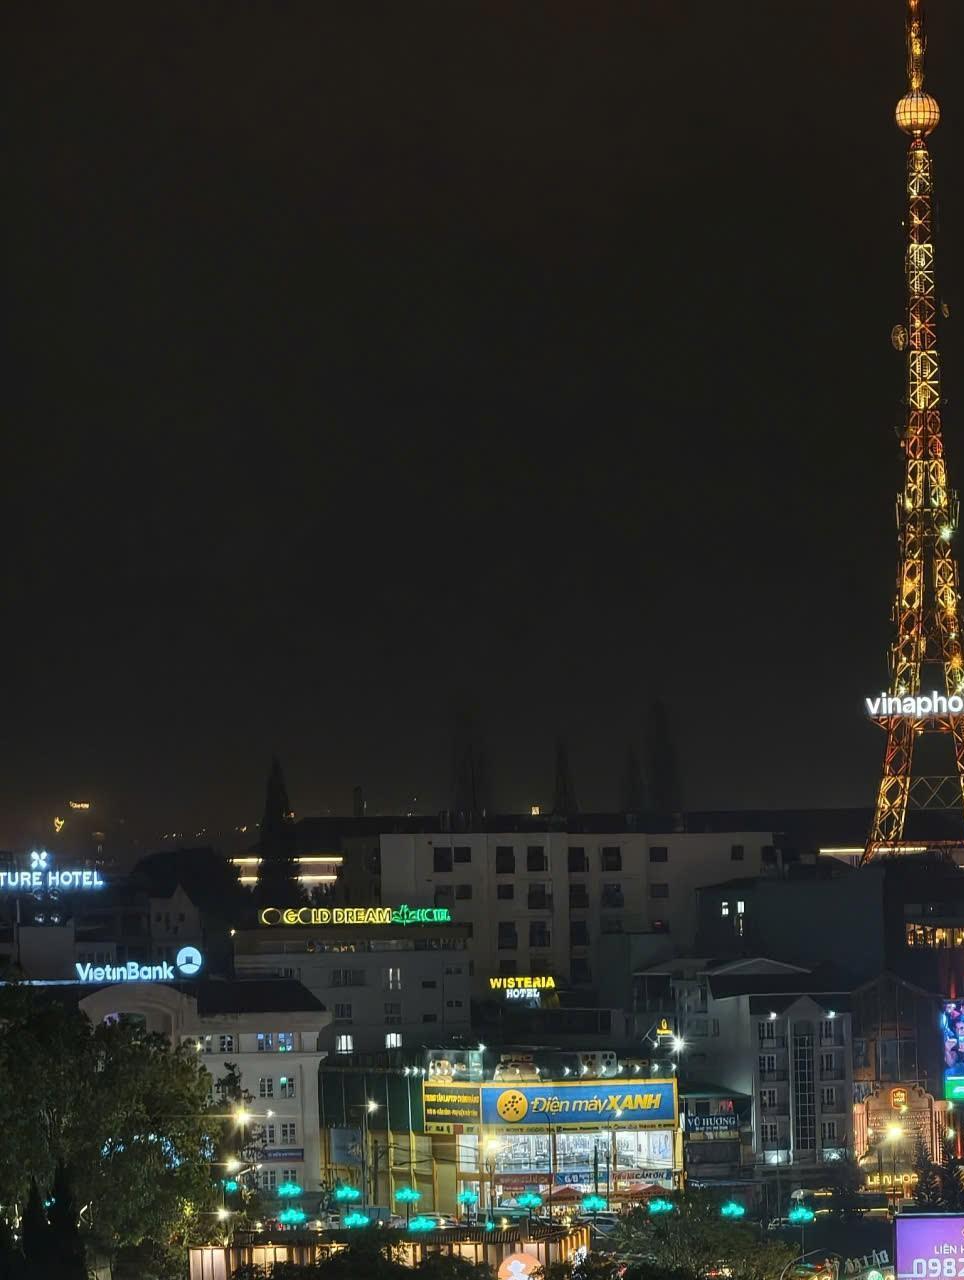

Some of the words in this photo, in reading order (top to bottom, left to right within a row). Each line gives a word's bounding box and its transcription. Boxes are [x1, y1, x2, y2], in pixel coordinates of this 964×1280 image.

[48, 871, 103, 886] HOTEL
[333, 907, 392, 924] DREAM
[75, 961, 175, 981] VietinBank
[489, 976, 556, 989] WISTERIA
[506, 988, 540, 999] HOTEL
[531, 1096, 570, 1115] Điện
[607, 1093, 662, 1112] XANH
[934, 1243, 958, 1255] LIÊN
